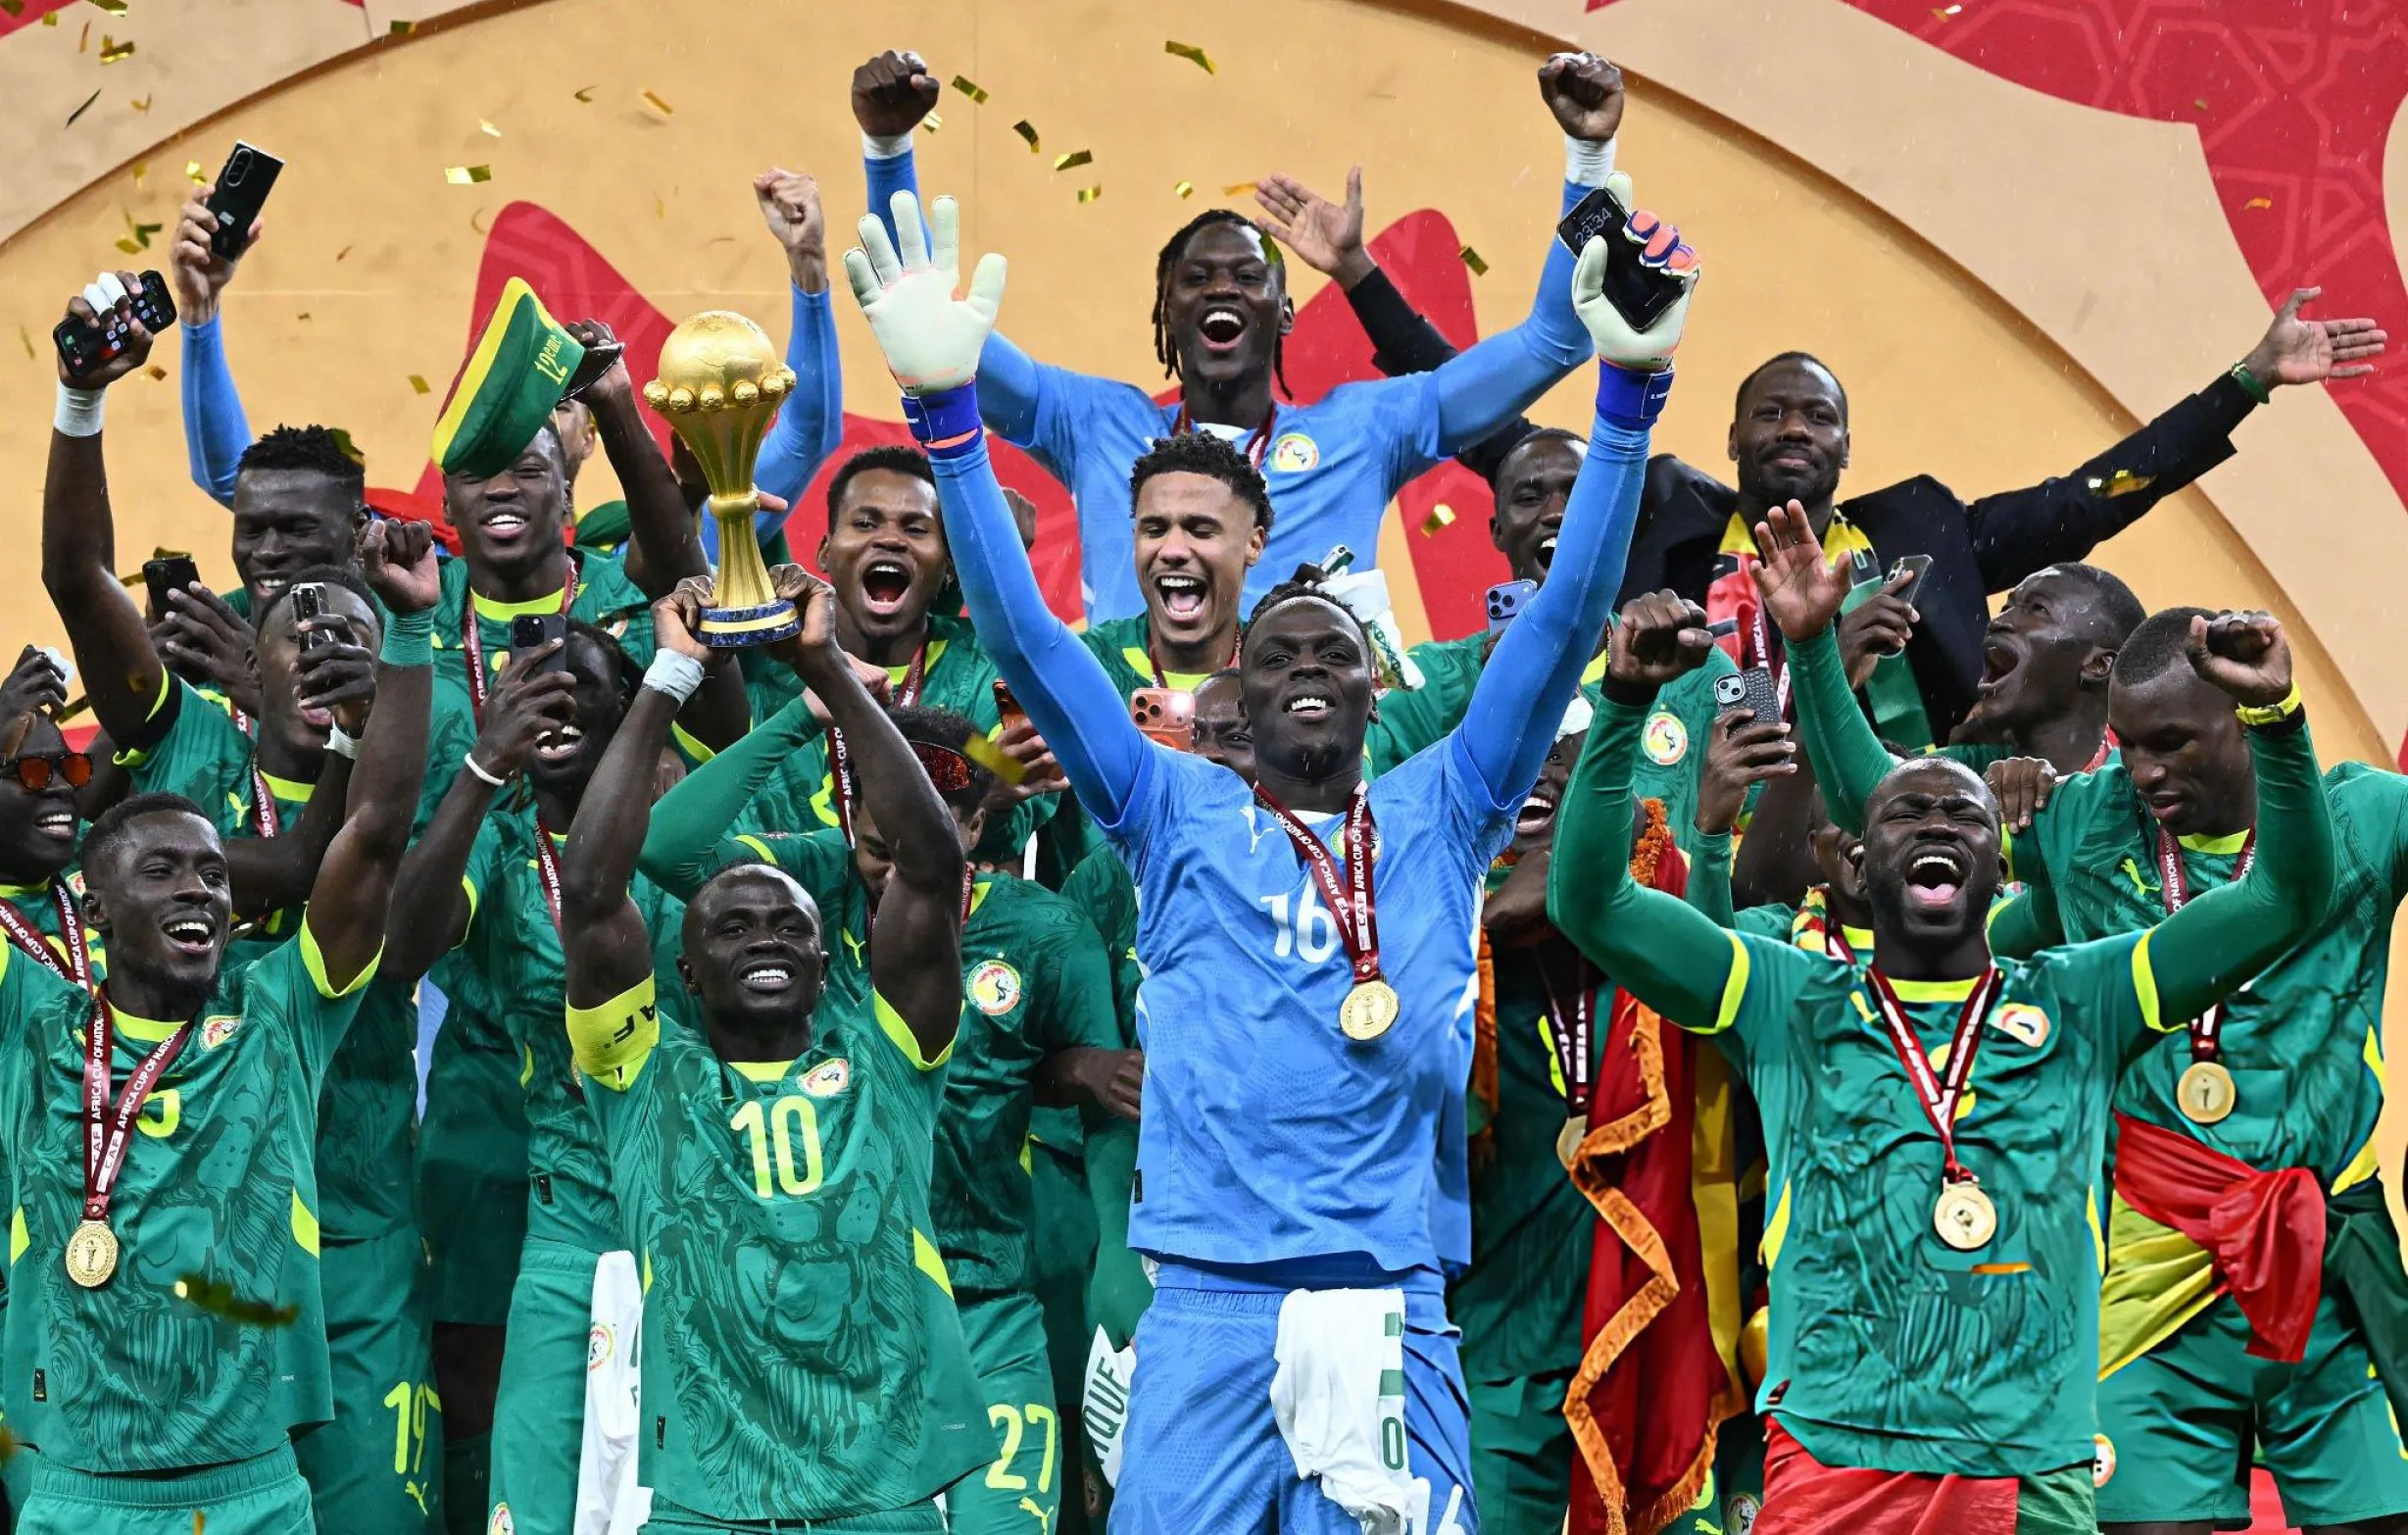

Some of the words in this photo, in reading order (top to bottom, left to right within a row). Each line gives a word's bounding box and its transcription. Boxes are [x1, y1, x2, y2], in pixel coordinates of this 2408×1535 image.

[1575, 207, 1612, 246] 23:34
[836, 740, 848, 760] CUP
[1275, 811, 1302, 840] NATIONS
[1298, 832, 1313, 846] OF
[1351, 825, 1362, 843] OF
[1306, 843, 1324, 861] CUP
[1352, 843, 1363, 862] CUP
[541, 853, 561, 888] NATIONS
[1321, 859, 1342, 896] AFRICA
[1354, 862, 1366, 891] AFRICA
[2165, 852, 2181, 897] NATIONS
[1259, 868, 1344, 964] 16
[1357, 897, 1367, 927] CAF
[2172, 898, 2184, 913] OF
[14, 927, 29, 939] OF
[65, 914, 76, 927] OF
[25, 936, 43, 955] CUP
[69, 926, 80, 946] CUP
[72, 945, 86, 978] AFRICA
[93, 1040, 105, 1058] OF
[92, 1057, 104, 1080] CUP
[91, 1079, 102, 1120] AFRICA
[104, 1135, 120, 1169] CAF
[117, 1092, 138, 1130] AFRICA
[133, 1070, 150, 1093] CUP
[144, 1056, 158, 1073] OF
[729, 1095, 824, 1199] 10
[383, 1381, 442, 1475] 19
[985, 1403, 1056, 1494] 27
